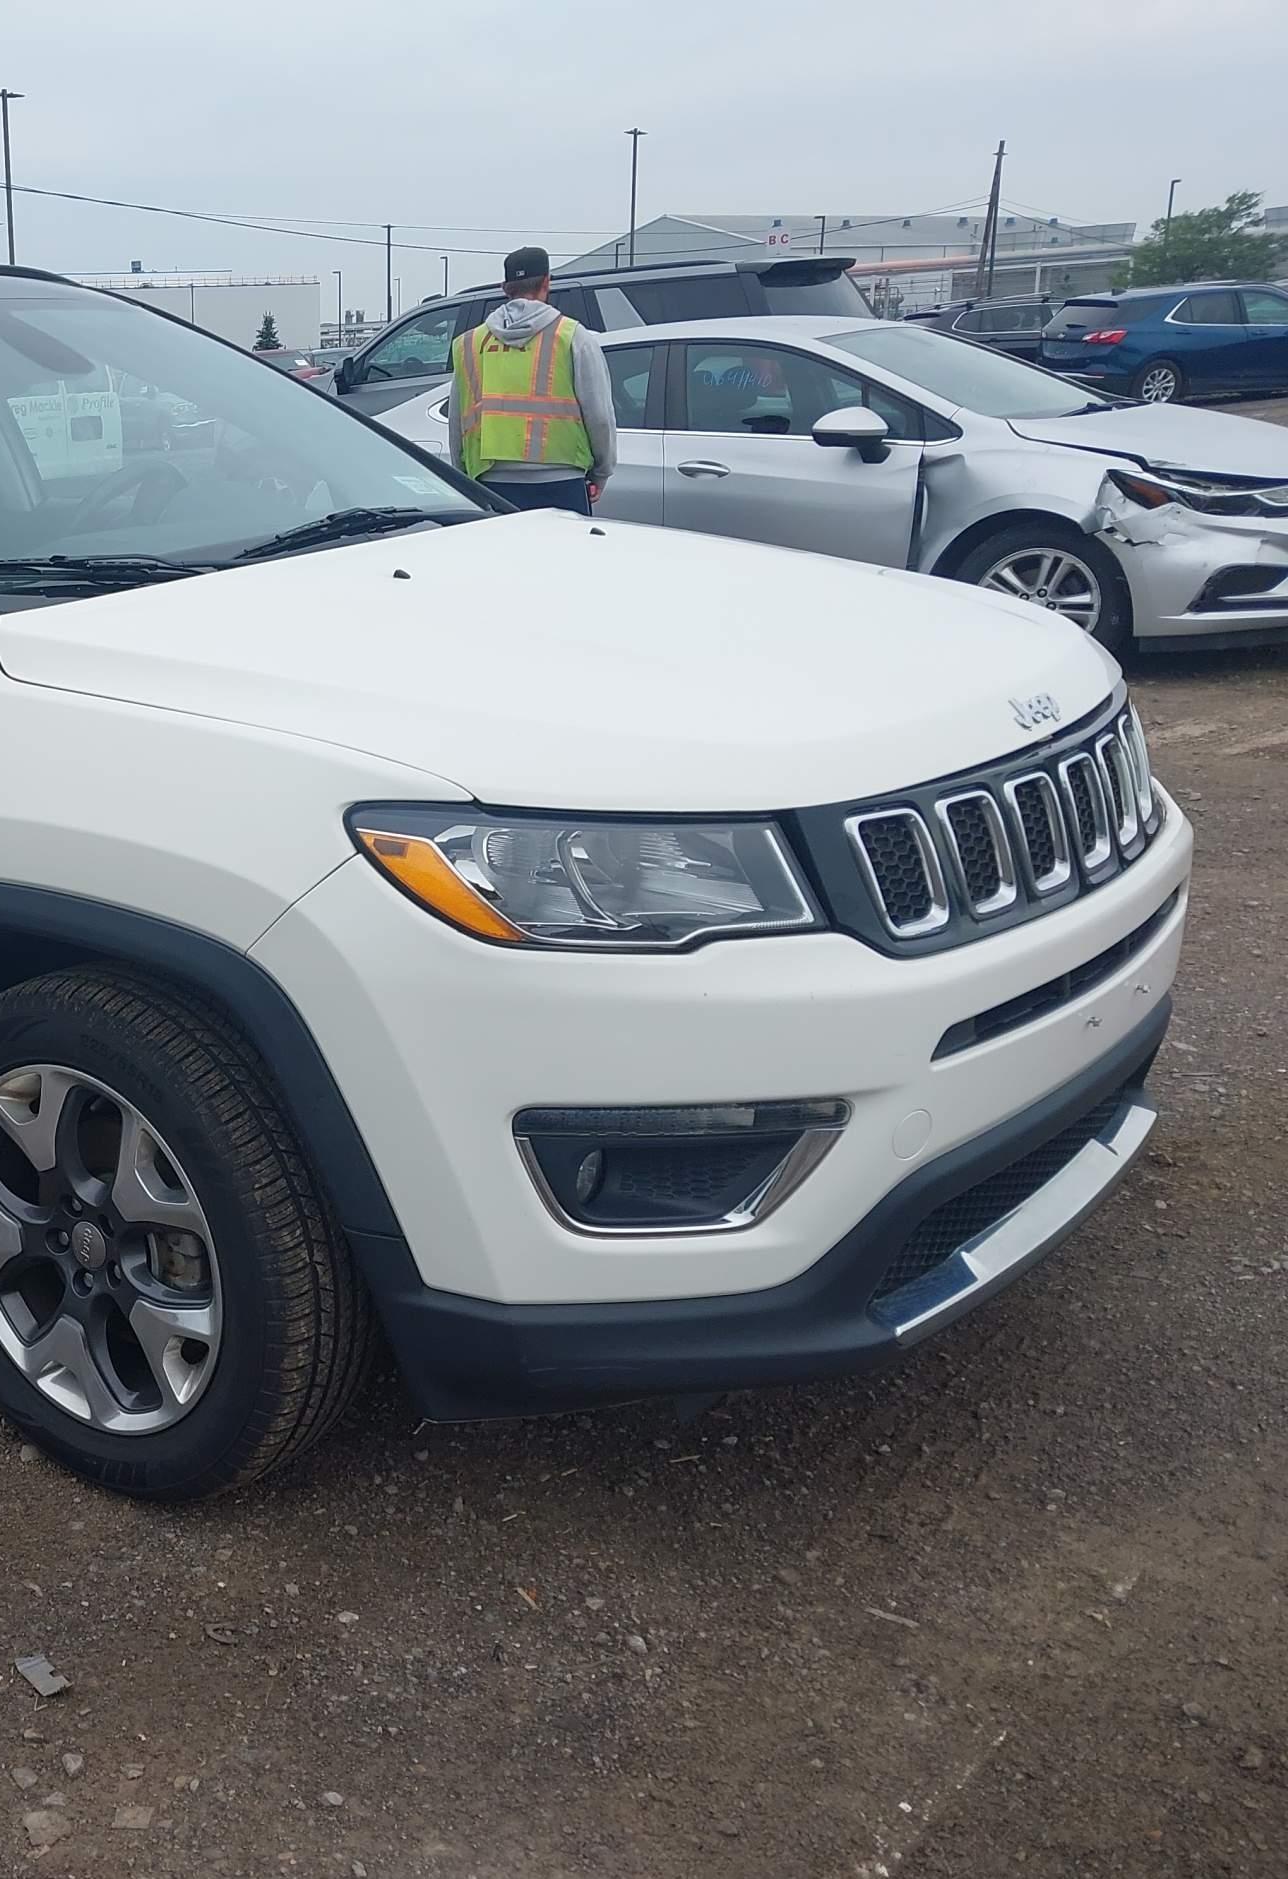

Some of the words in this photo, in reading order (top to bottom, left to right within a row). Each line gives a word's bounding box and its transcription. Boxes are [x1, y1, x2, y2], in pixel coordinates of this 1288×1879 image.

[768, 235, 777, 245] B
[780, 233, 789, 244] C
[1008, 693, 1061, 731] Jeep
[79, 1228, 94, 1262] Jeep
